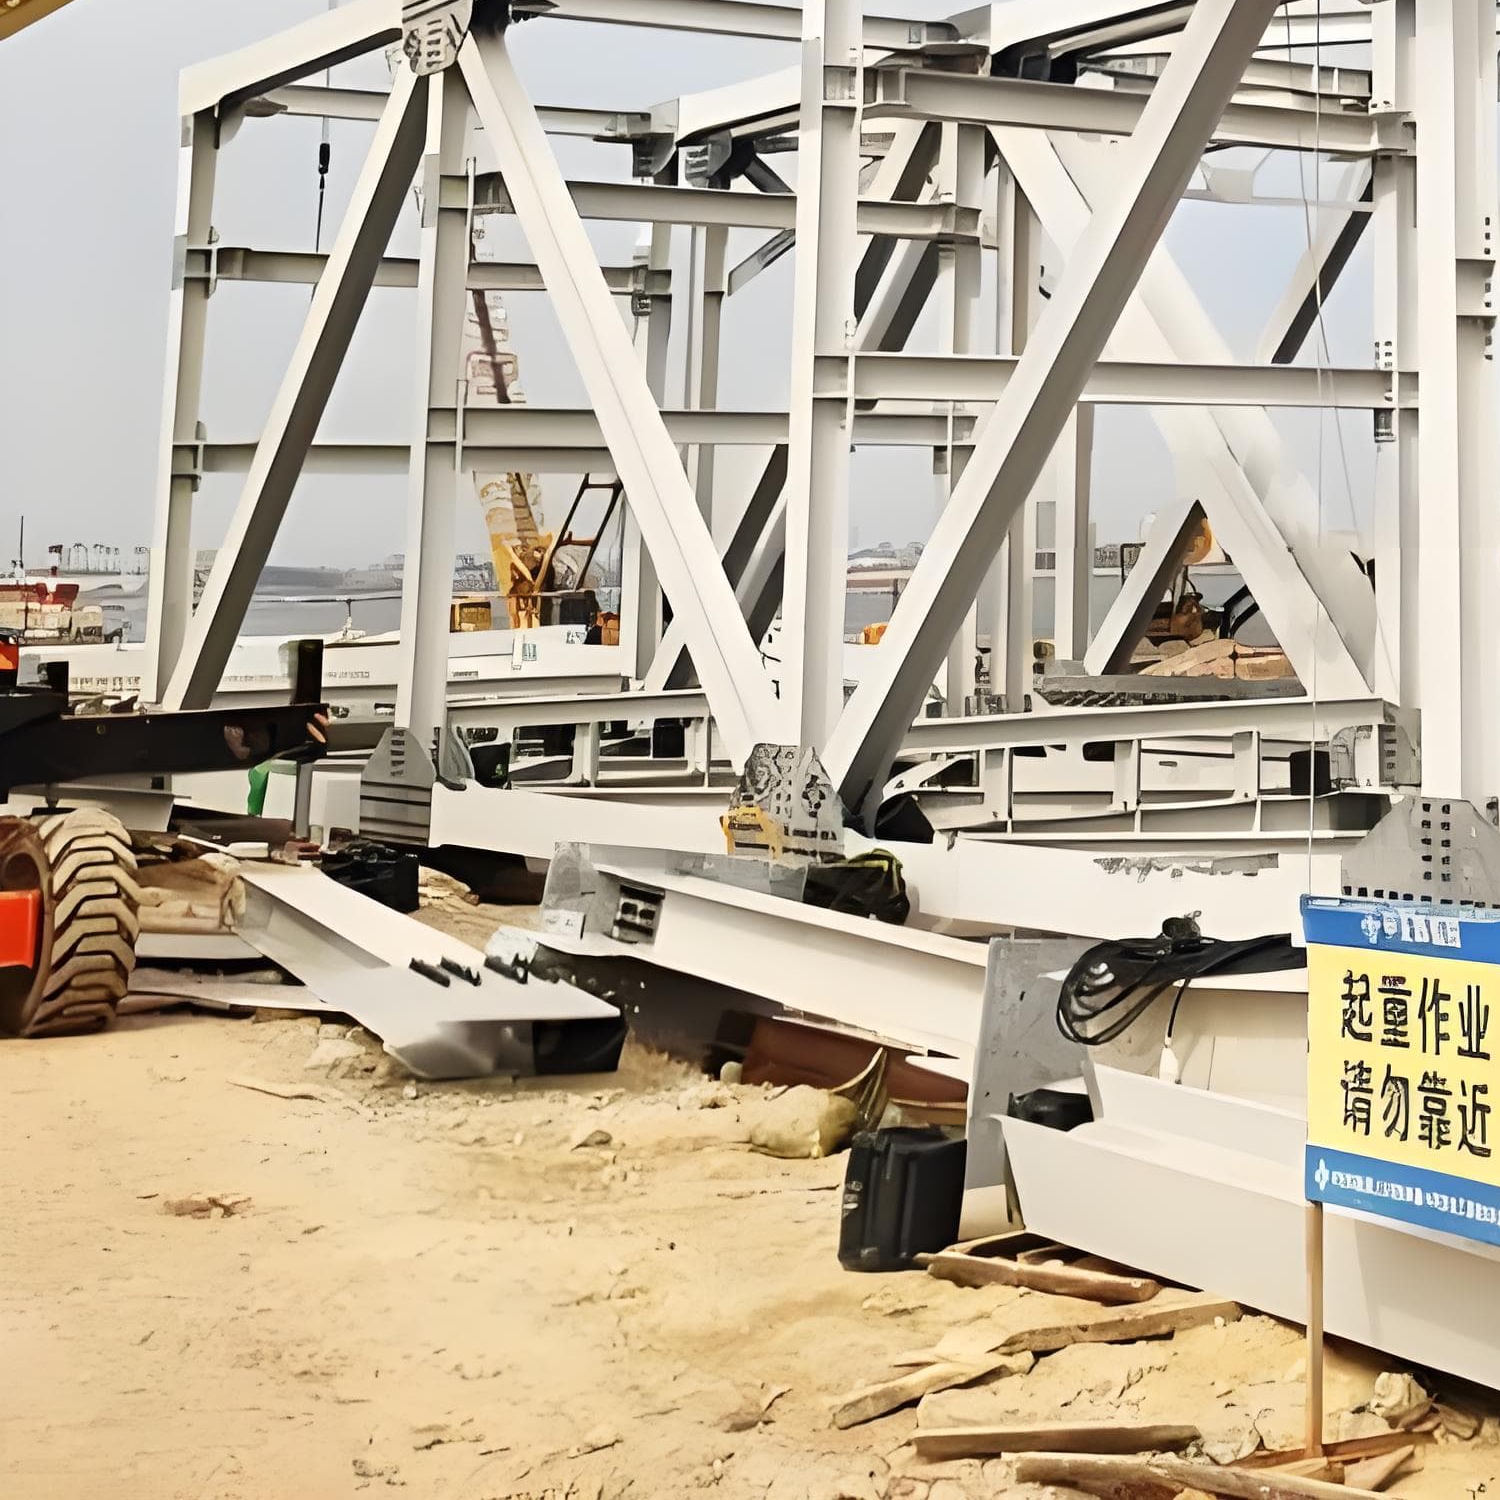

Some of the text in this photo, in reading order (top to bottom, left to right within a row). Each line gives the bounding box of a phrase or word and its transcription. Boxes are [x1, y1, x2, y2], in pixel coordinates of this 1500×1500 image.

[1341, 969, 1490, 1060] 起重作业
[1340, 1060, 1491, 1158] 请勿靠近
